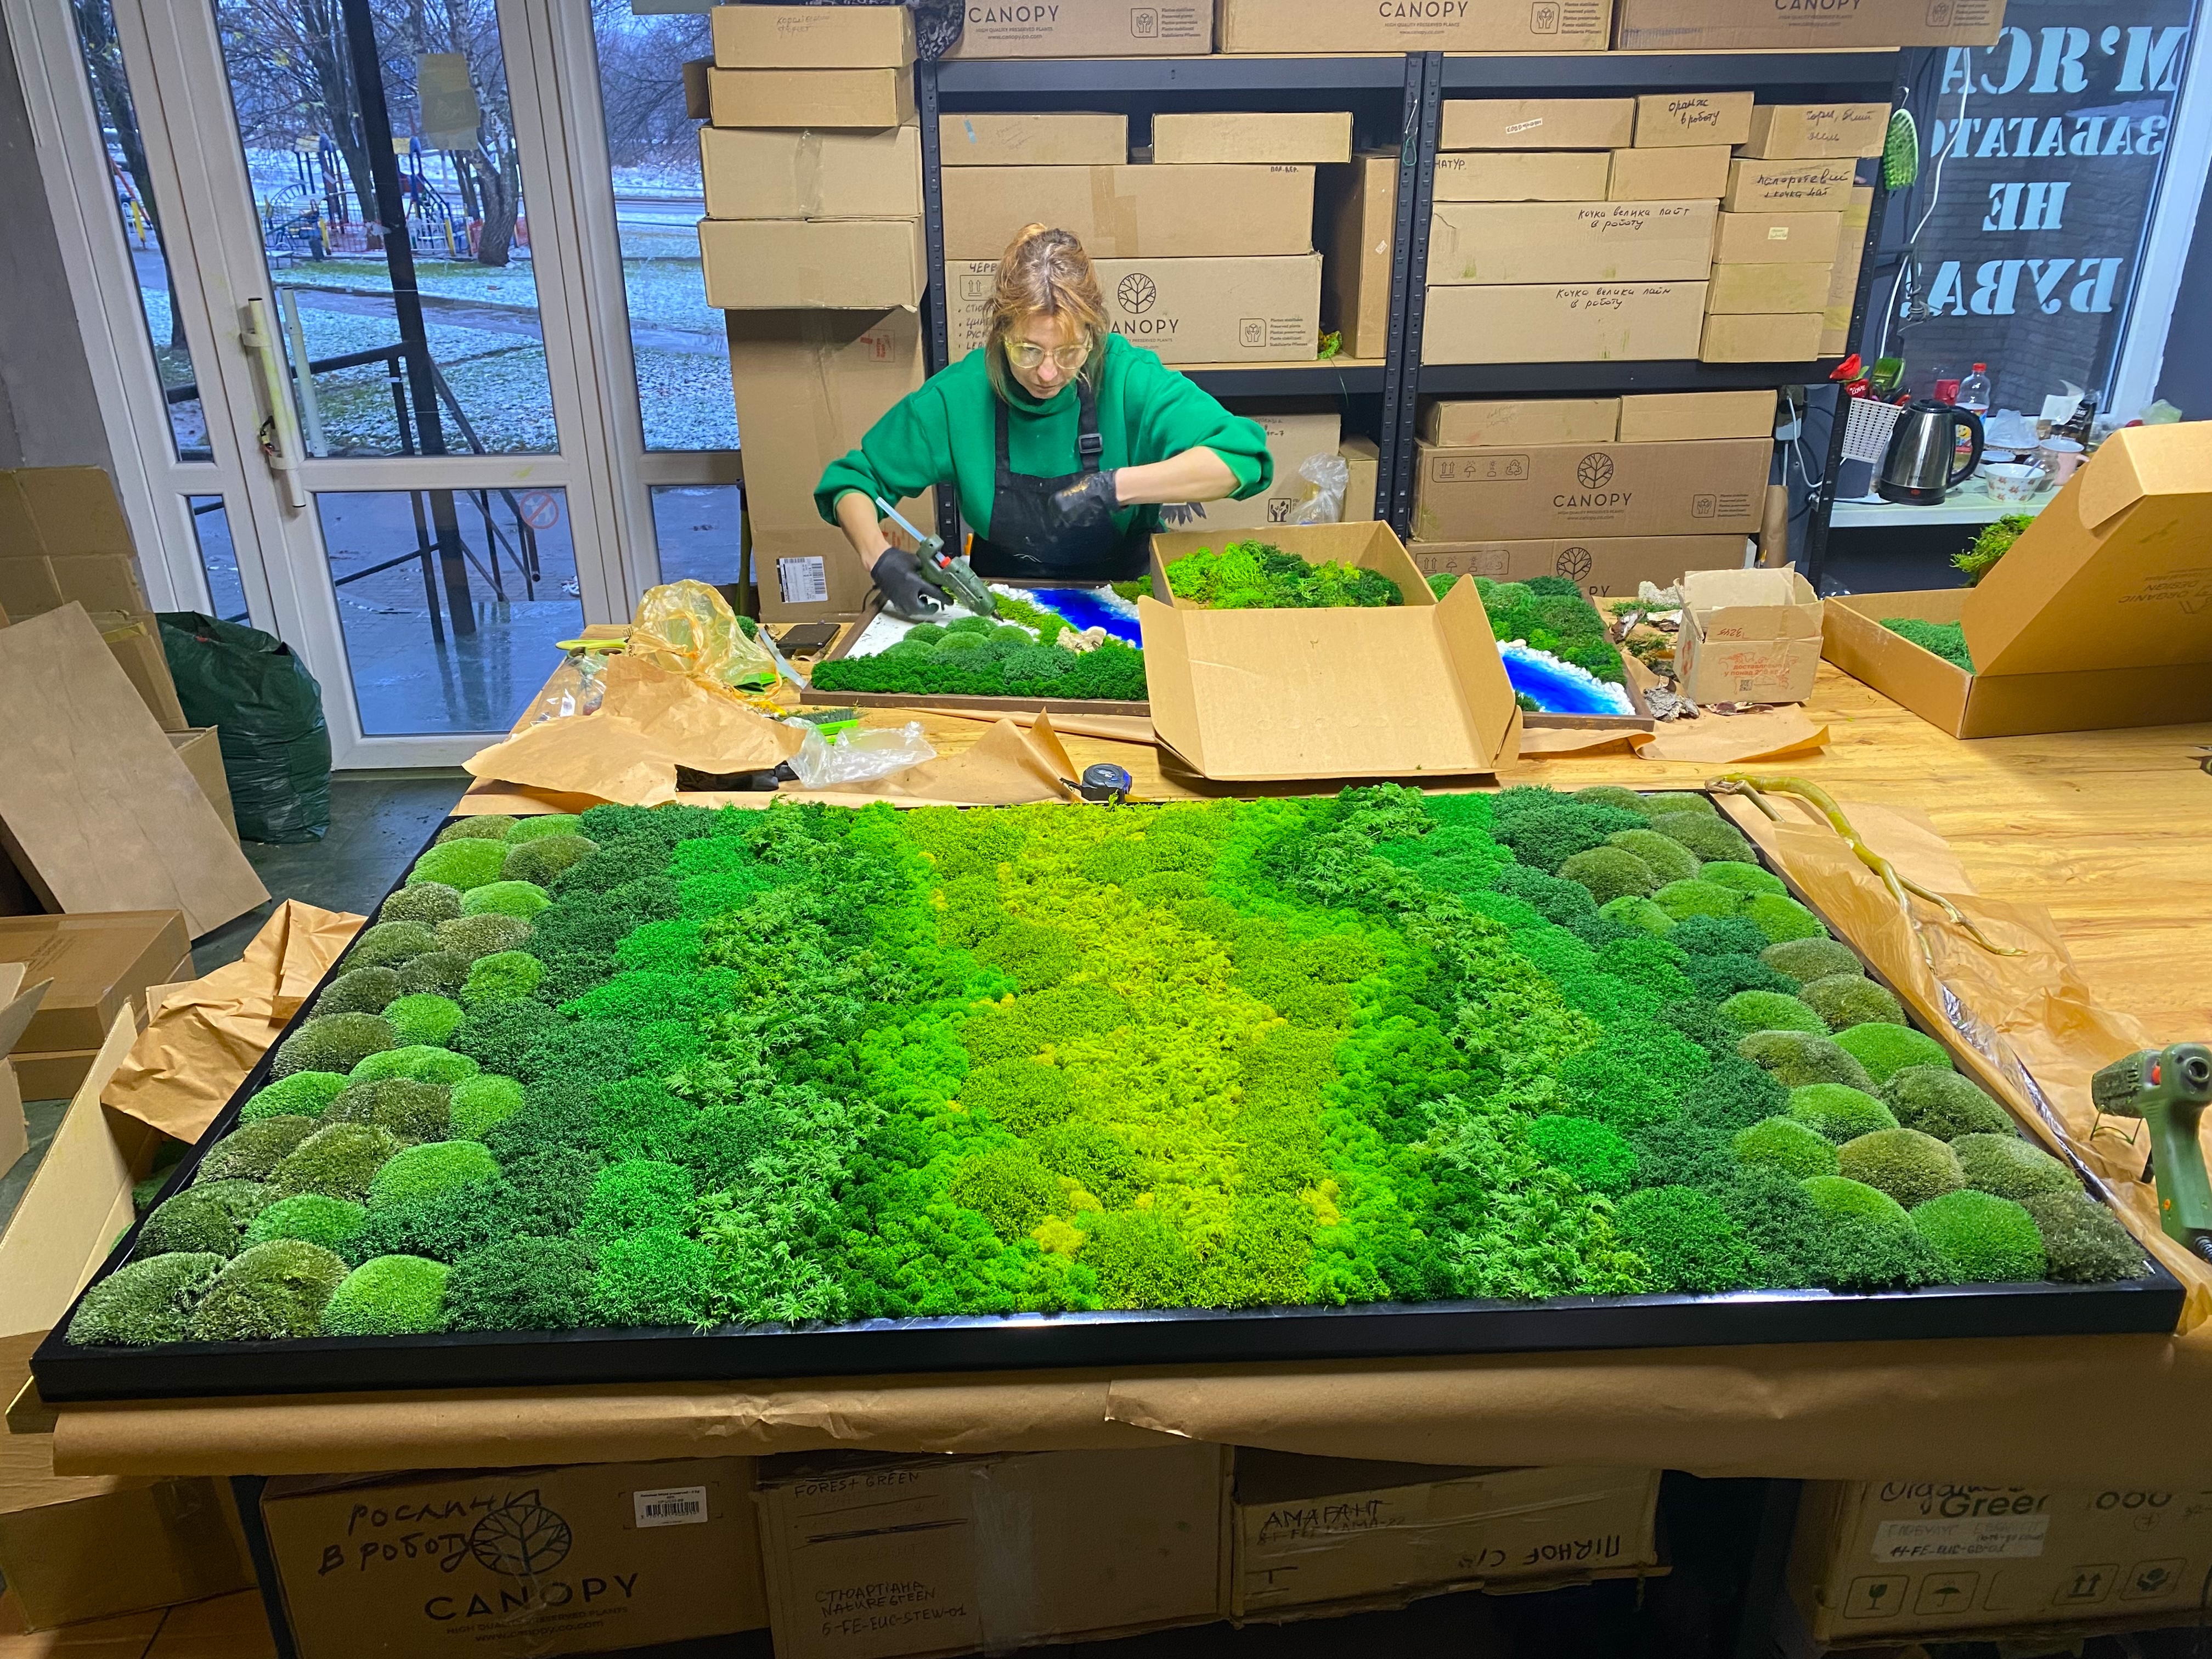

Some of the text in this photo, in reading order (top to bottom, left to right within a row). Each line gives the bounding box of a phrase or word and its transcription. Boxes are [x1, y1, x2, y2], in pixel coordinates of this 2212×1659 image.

[1379, 1, 1468, 18] CANOPY
[1775, 0, 1860, 10] CANOPY
[968, 5, 1059, 23] CANOPY
[1602, 219, 1644, 233] роботу
[1585, 298, 1622, 309] роботу
[1111, 319, 1179, 334] ANOPY
[1852, 385, 1866, 395] LOVE
[1553, 493, 1632, 507] CANOPY
[2144, 580, 2200, 591] DESIGN
[2118, 590, 2189, 603] ORGANIC
[866, 1472, 919, 1487] GREEN
[424, 1573, 638, 1620] CANOPY
[447, 1625, 475, 1635] HIGH
[589, 1606, 629, 1617] PLANTS
